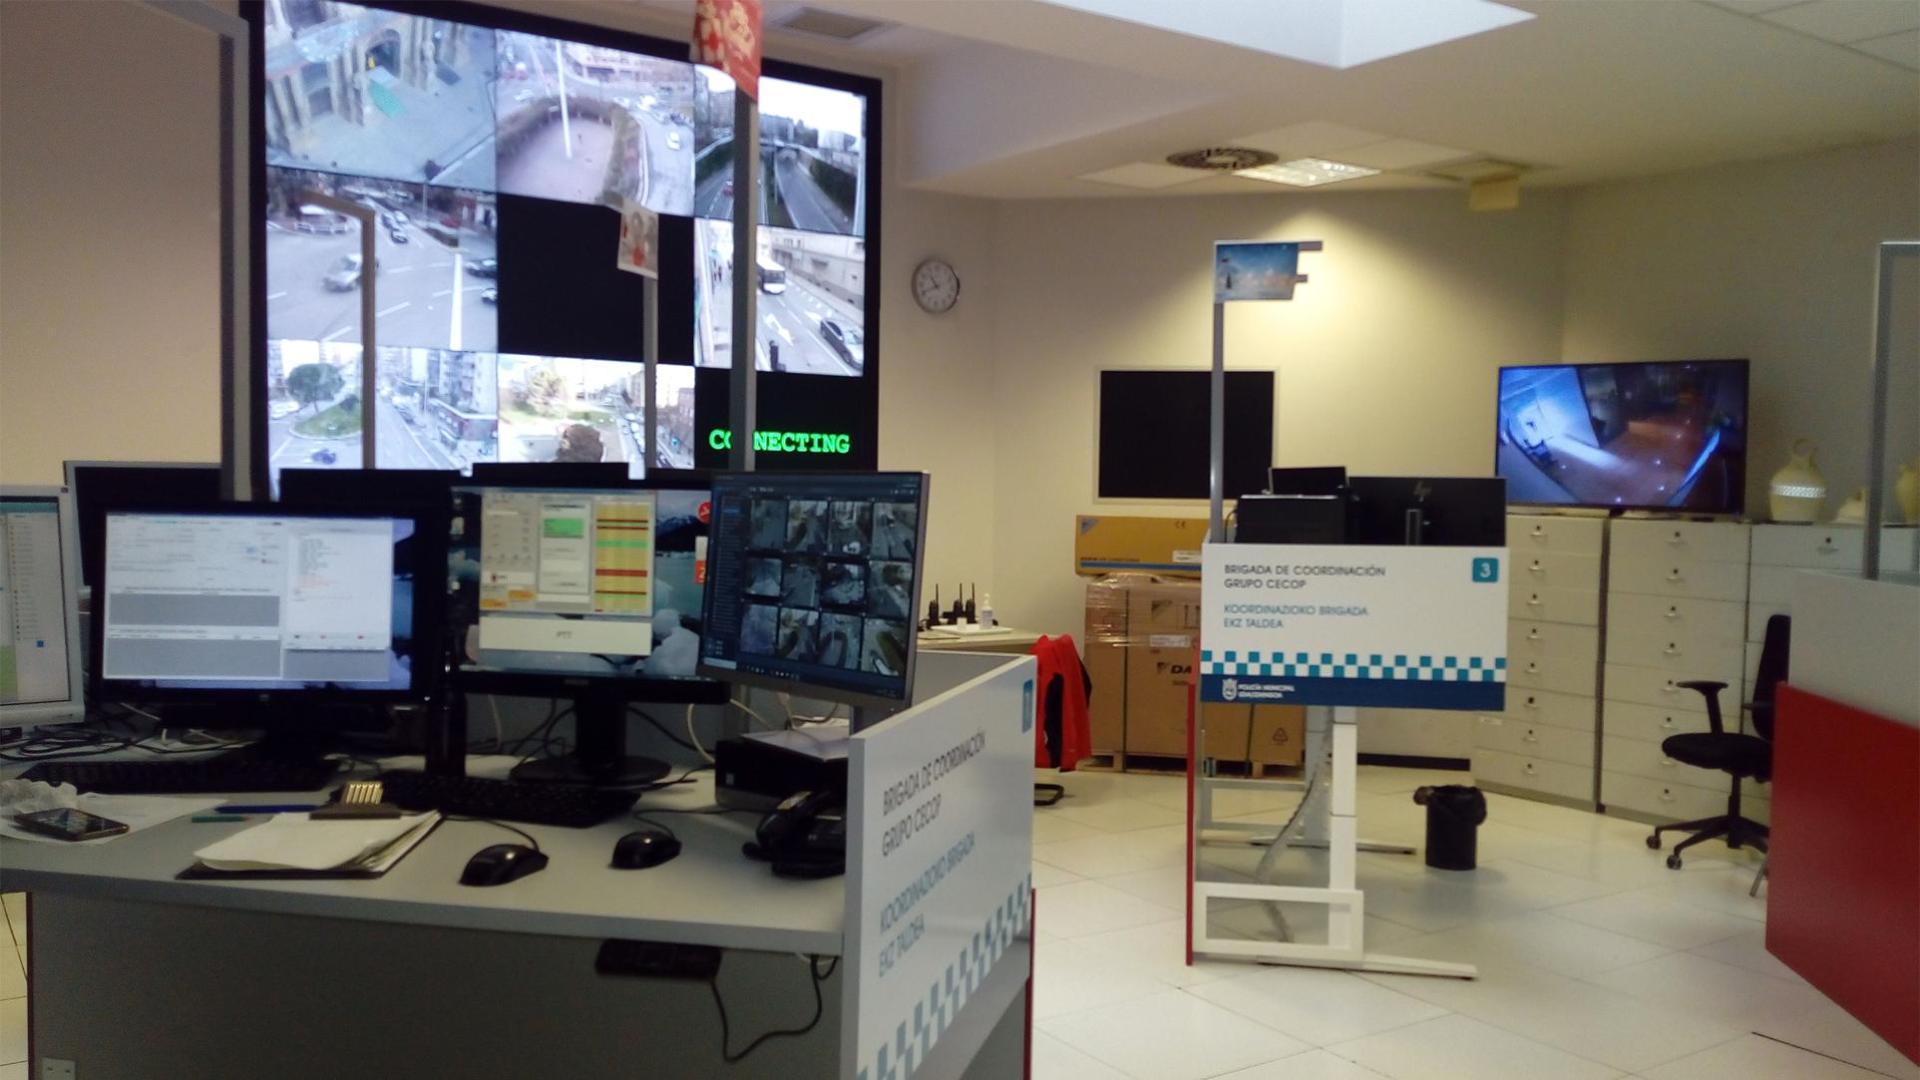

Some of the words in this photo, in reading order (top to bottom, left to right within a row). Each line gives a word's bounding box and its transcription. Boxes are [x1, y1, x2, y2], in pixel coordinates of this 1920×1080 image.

[708, 428, 850, 454] CONECTING
[1224, 564, 1272, 575] BRIGADA
[1275, 565, 1289, 575] DE
[1293, 565, 1385, 576] COORDINACIÓN
[1480, 562, 1491, 578] 3
[1224, 578, 1263, 588] GRUPO
[1266, 579, 1306, 589] CECOP
[1223, 604, 1316, 615] KOORDINAZIOKO
[1319, 606, 1368, 616] BRIGADA
[1223, 617, 1242, 628] EKZ
[1245, 618, 1284, 628] TALDEA
[883, 771, 920, 817] BRIGADA
[921, 762, 933, 790] DE
[933, 729, 985, 781] COORDINACIÓN
[882, 814, 912, 857] GRUPO
[914, 793, 942, 833] CECOP
[946, 831, 975, 873] BRIGADA
[896, 912, 925, 959] TALDEA
